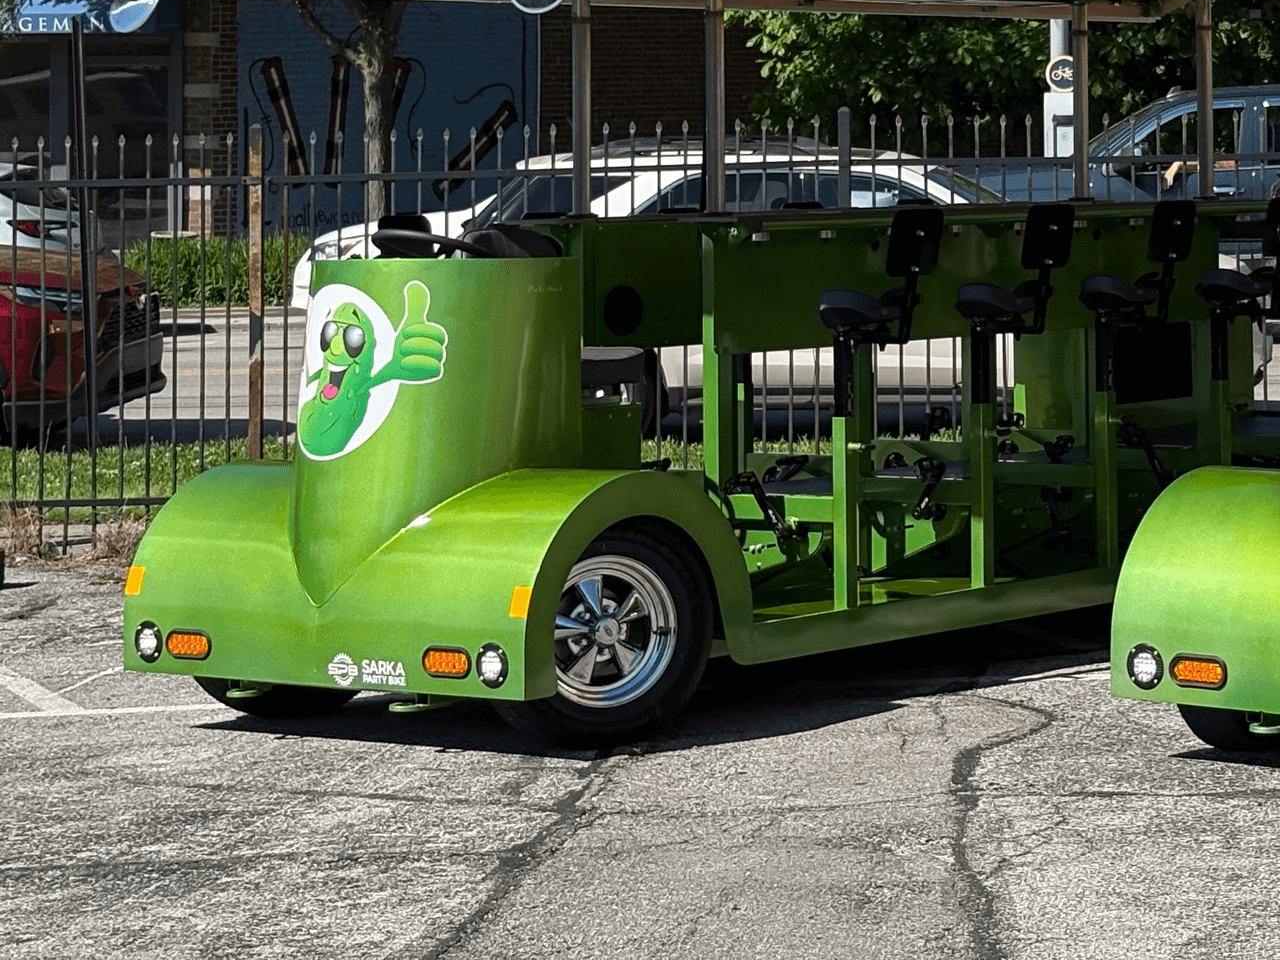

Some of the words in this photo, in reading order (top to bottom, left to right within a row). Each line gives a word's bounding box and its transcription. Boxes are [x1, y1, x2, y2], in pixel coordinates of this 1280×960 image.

[328, 662, 359, 677] SPB
[361, 659, 406, 677] SARKA
[362, 673, 388, 685] PARTY
[387, 675, 407, 687] BIKE
